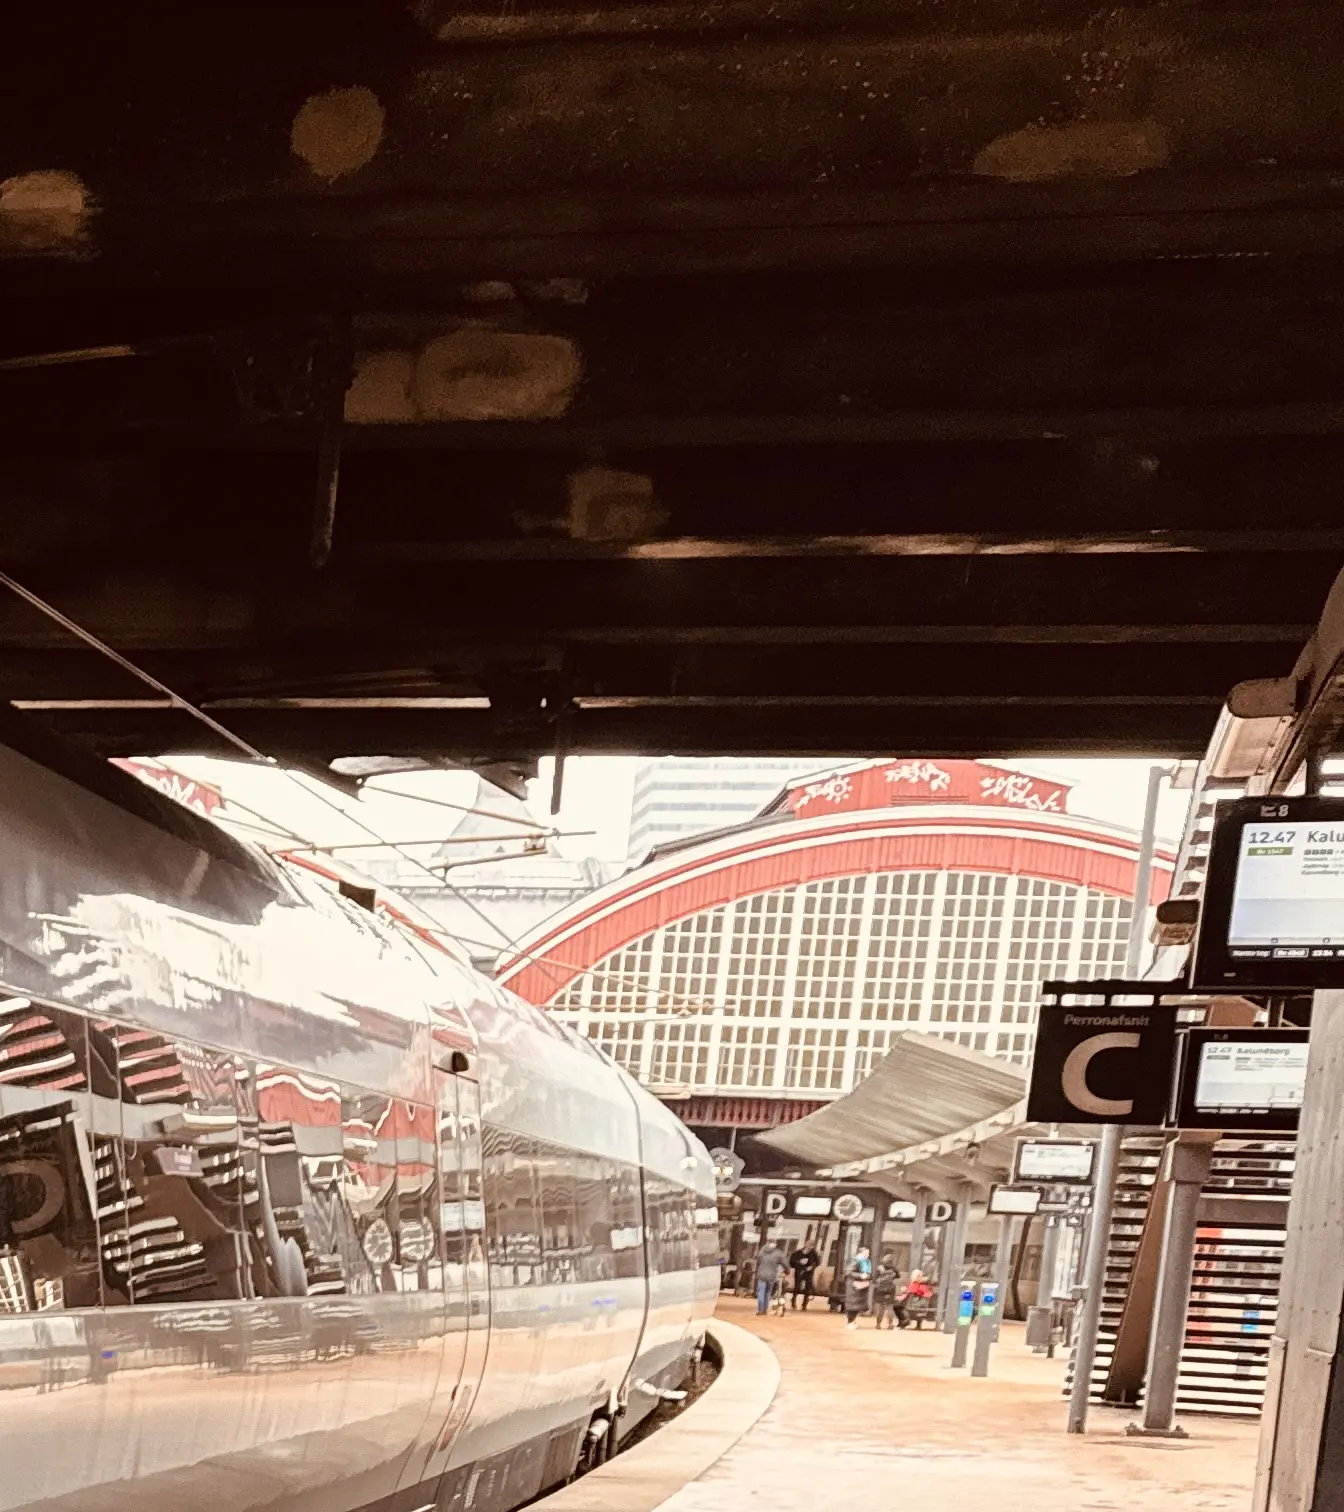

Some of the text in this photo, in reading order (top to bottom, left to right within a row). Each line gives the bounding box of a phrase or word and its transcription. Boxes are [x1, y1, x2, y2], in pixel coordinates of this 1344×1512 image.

[1248, 831, 1296, 844] 12.47
[1061, 1032, 1141, 1116] C
[765, 1193, 787, 1214] D
[931, 1201, 953, 1221] D
